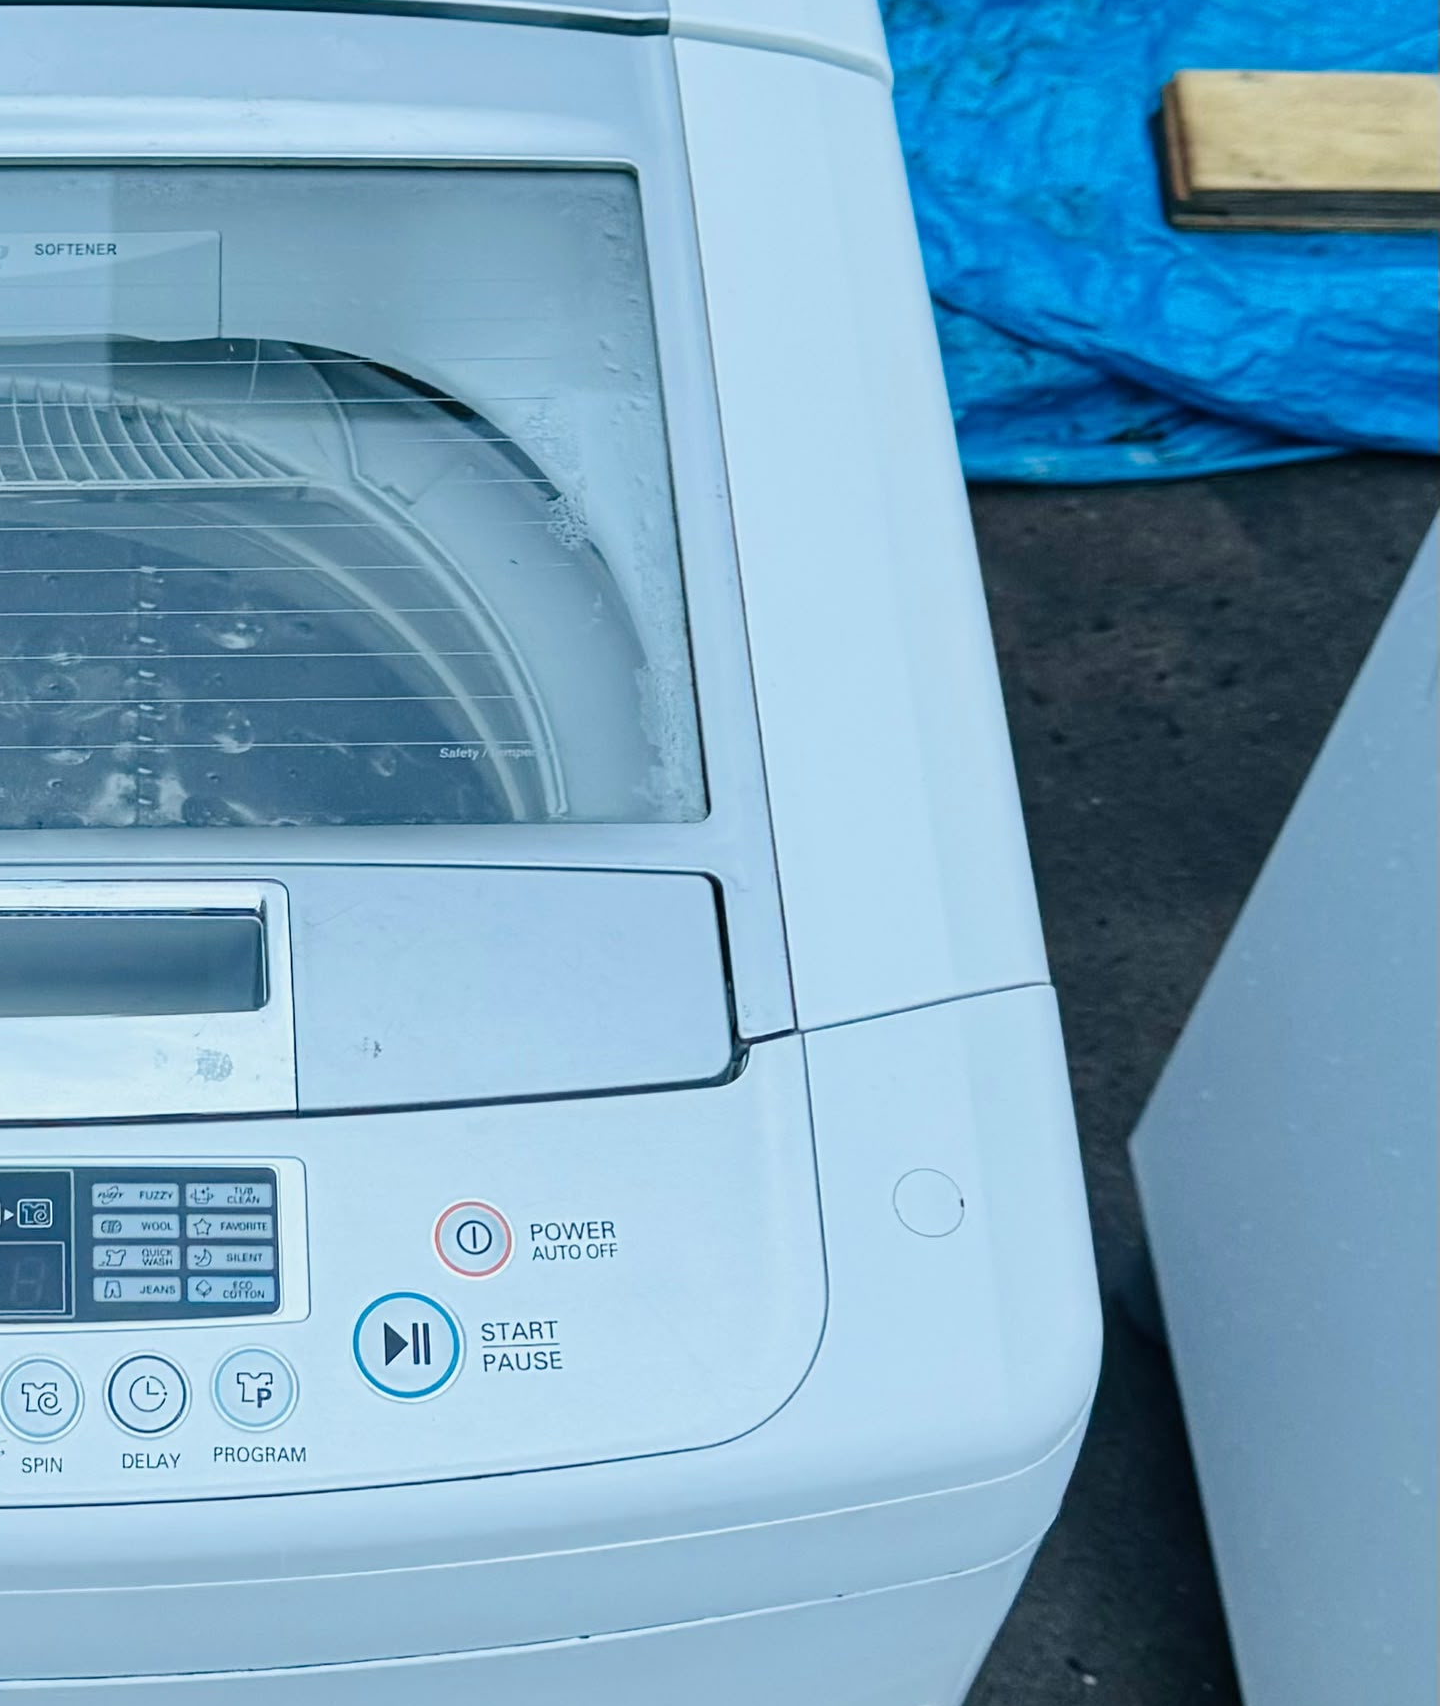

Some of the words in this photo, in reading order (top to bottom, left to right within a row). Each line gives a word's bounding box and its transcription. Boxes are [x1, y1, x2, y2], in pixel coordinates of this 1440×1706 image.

[34, 243, 117, 255] SOFTENER
[439, 747, 479, 760] Safety
[140, 1192, 173, 1201] FUZZY
[227, 1195, 260, 1205] CLEAN
[141, 1221, 173, 1231] WOOL
[220, 1222, 268, 1232] FAVORITE
[530, 1221, 616, 1242] POWER
[141, 1248, 173, 1257] QUICK
[532, 1245, 582, 1261] AUTO
[586, 1243, 618, 1259] OFF
[142, 1257, 173, 1267] WASH
[226, 1253, 263, 1262] SILENT
[140, 1285, 176, 1295] JEANS
[232, 1281, 253, 1290] ECO
[222, 1290, 265, 1299] COTTON
[481, 1321, 559, 1342] START
[483, 1351, 563, 1372] PAUSE
[213, 1447, 307, 1463] PROGRAM
[21, 1457, 63, 1474] SPIN
[122, 1453, 181, 1469] DELAY
